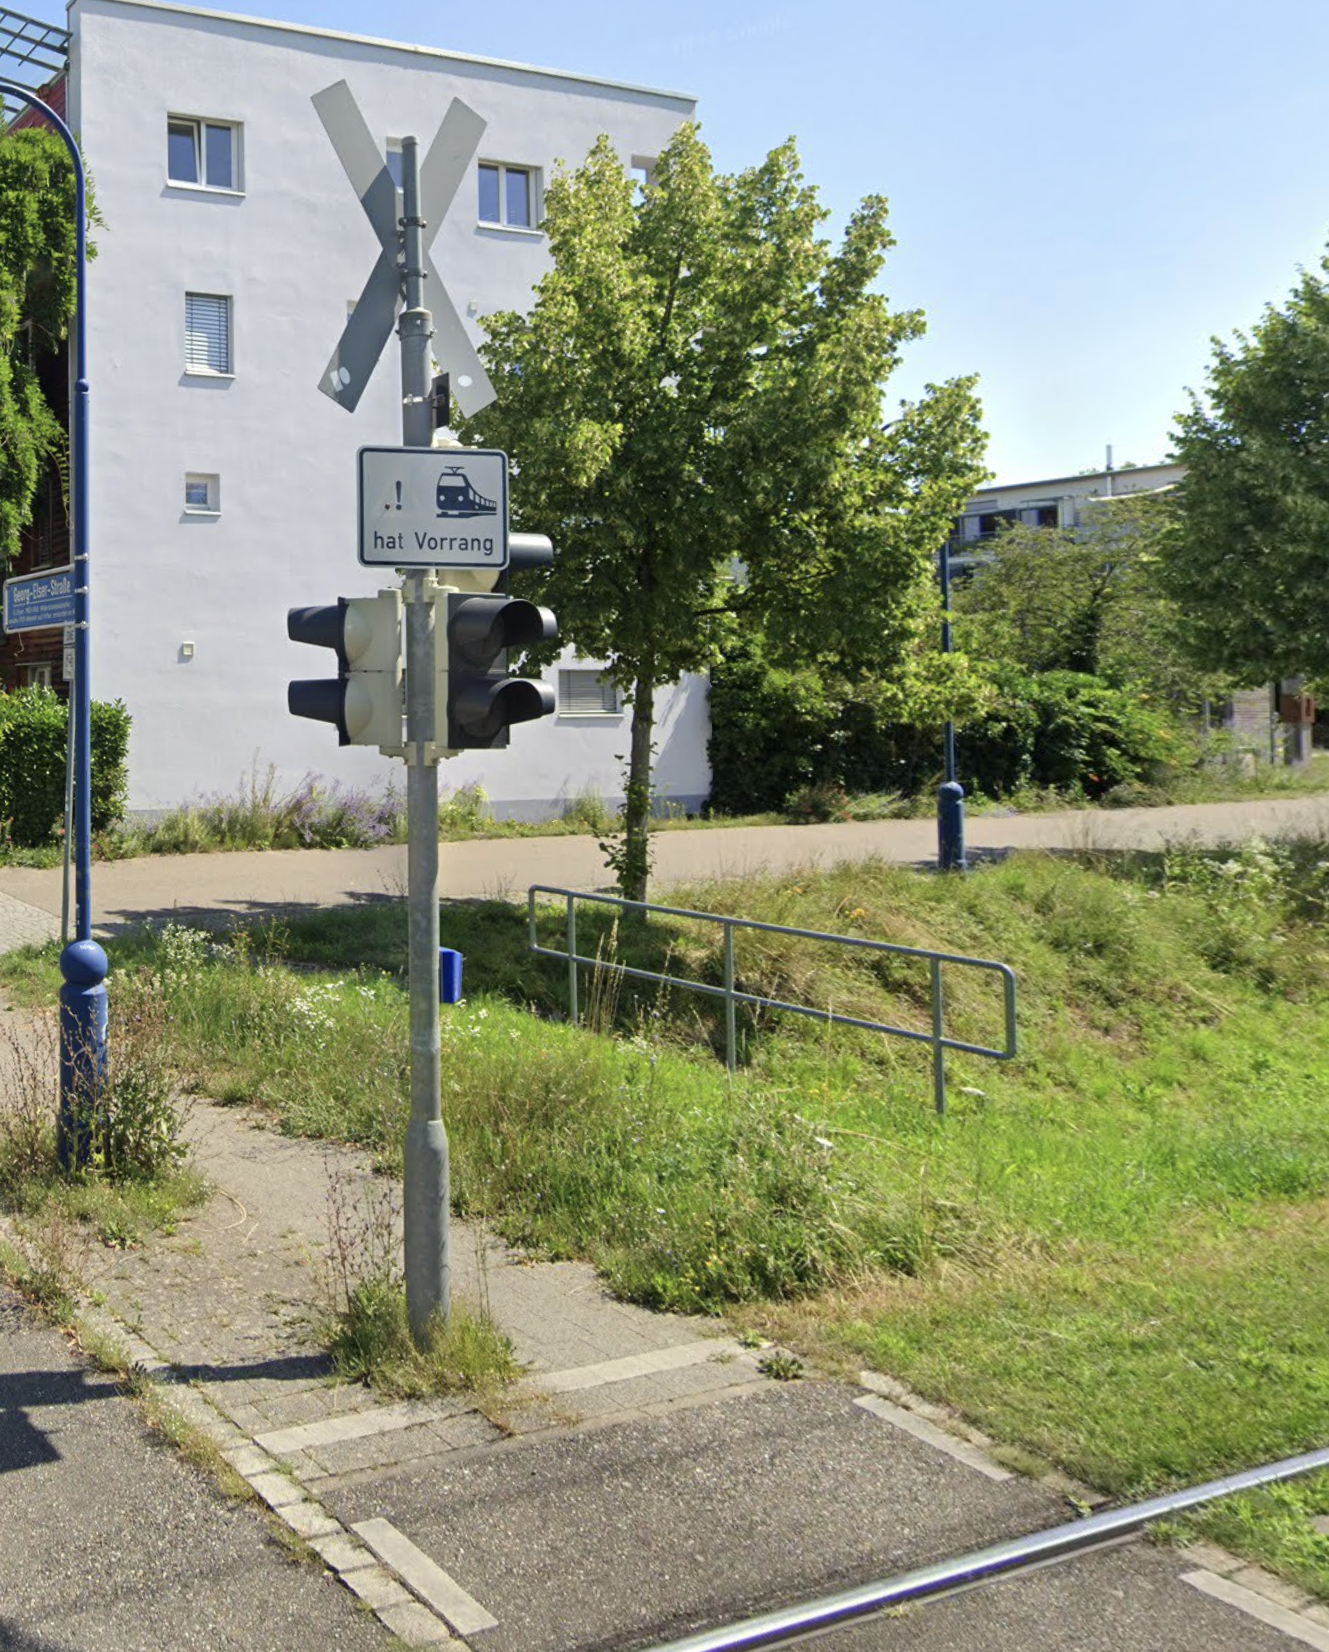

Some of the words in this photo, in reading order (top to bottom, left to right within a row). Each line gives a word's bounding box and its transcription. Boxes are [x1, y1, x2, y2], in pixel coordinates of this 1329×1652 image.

[374, 531, 404, 550] hat
[414, 531, 494, 556] Vorrang
[13, 577, 71, 604] Georg-Elser-Straße
